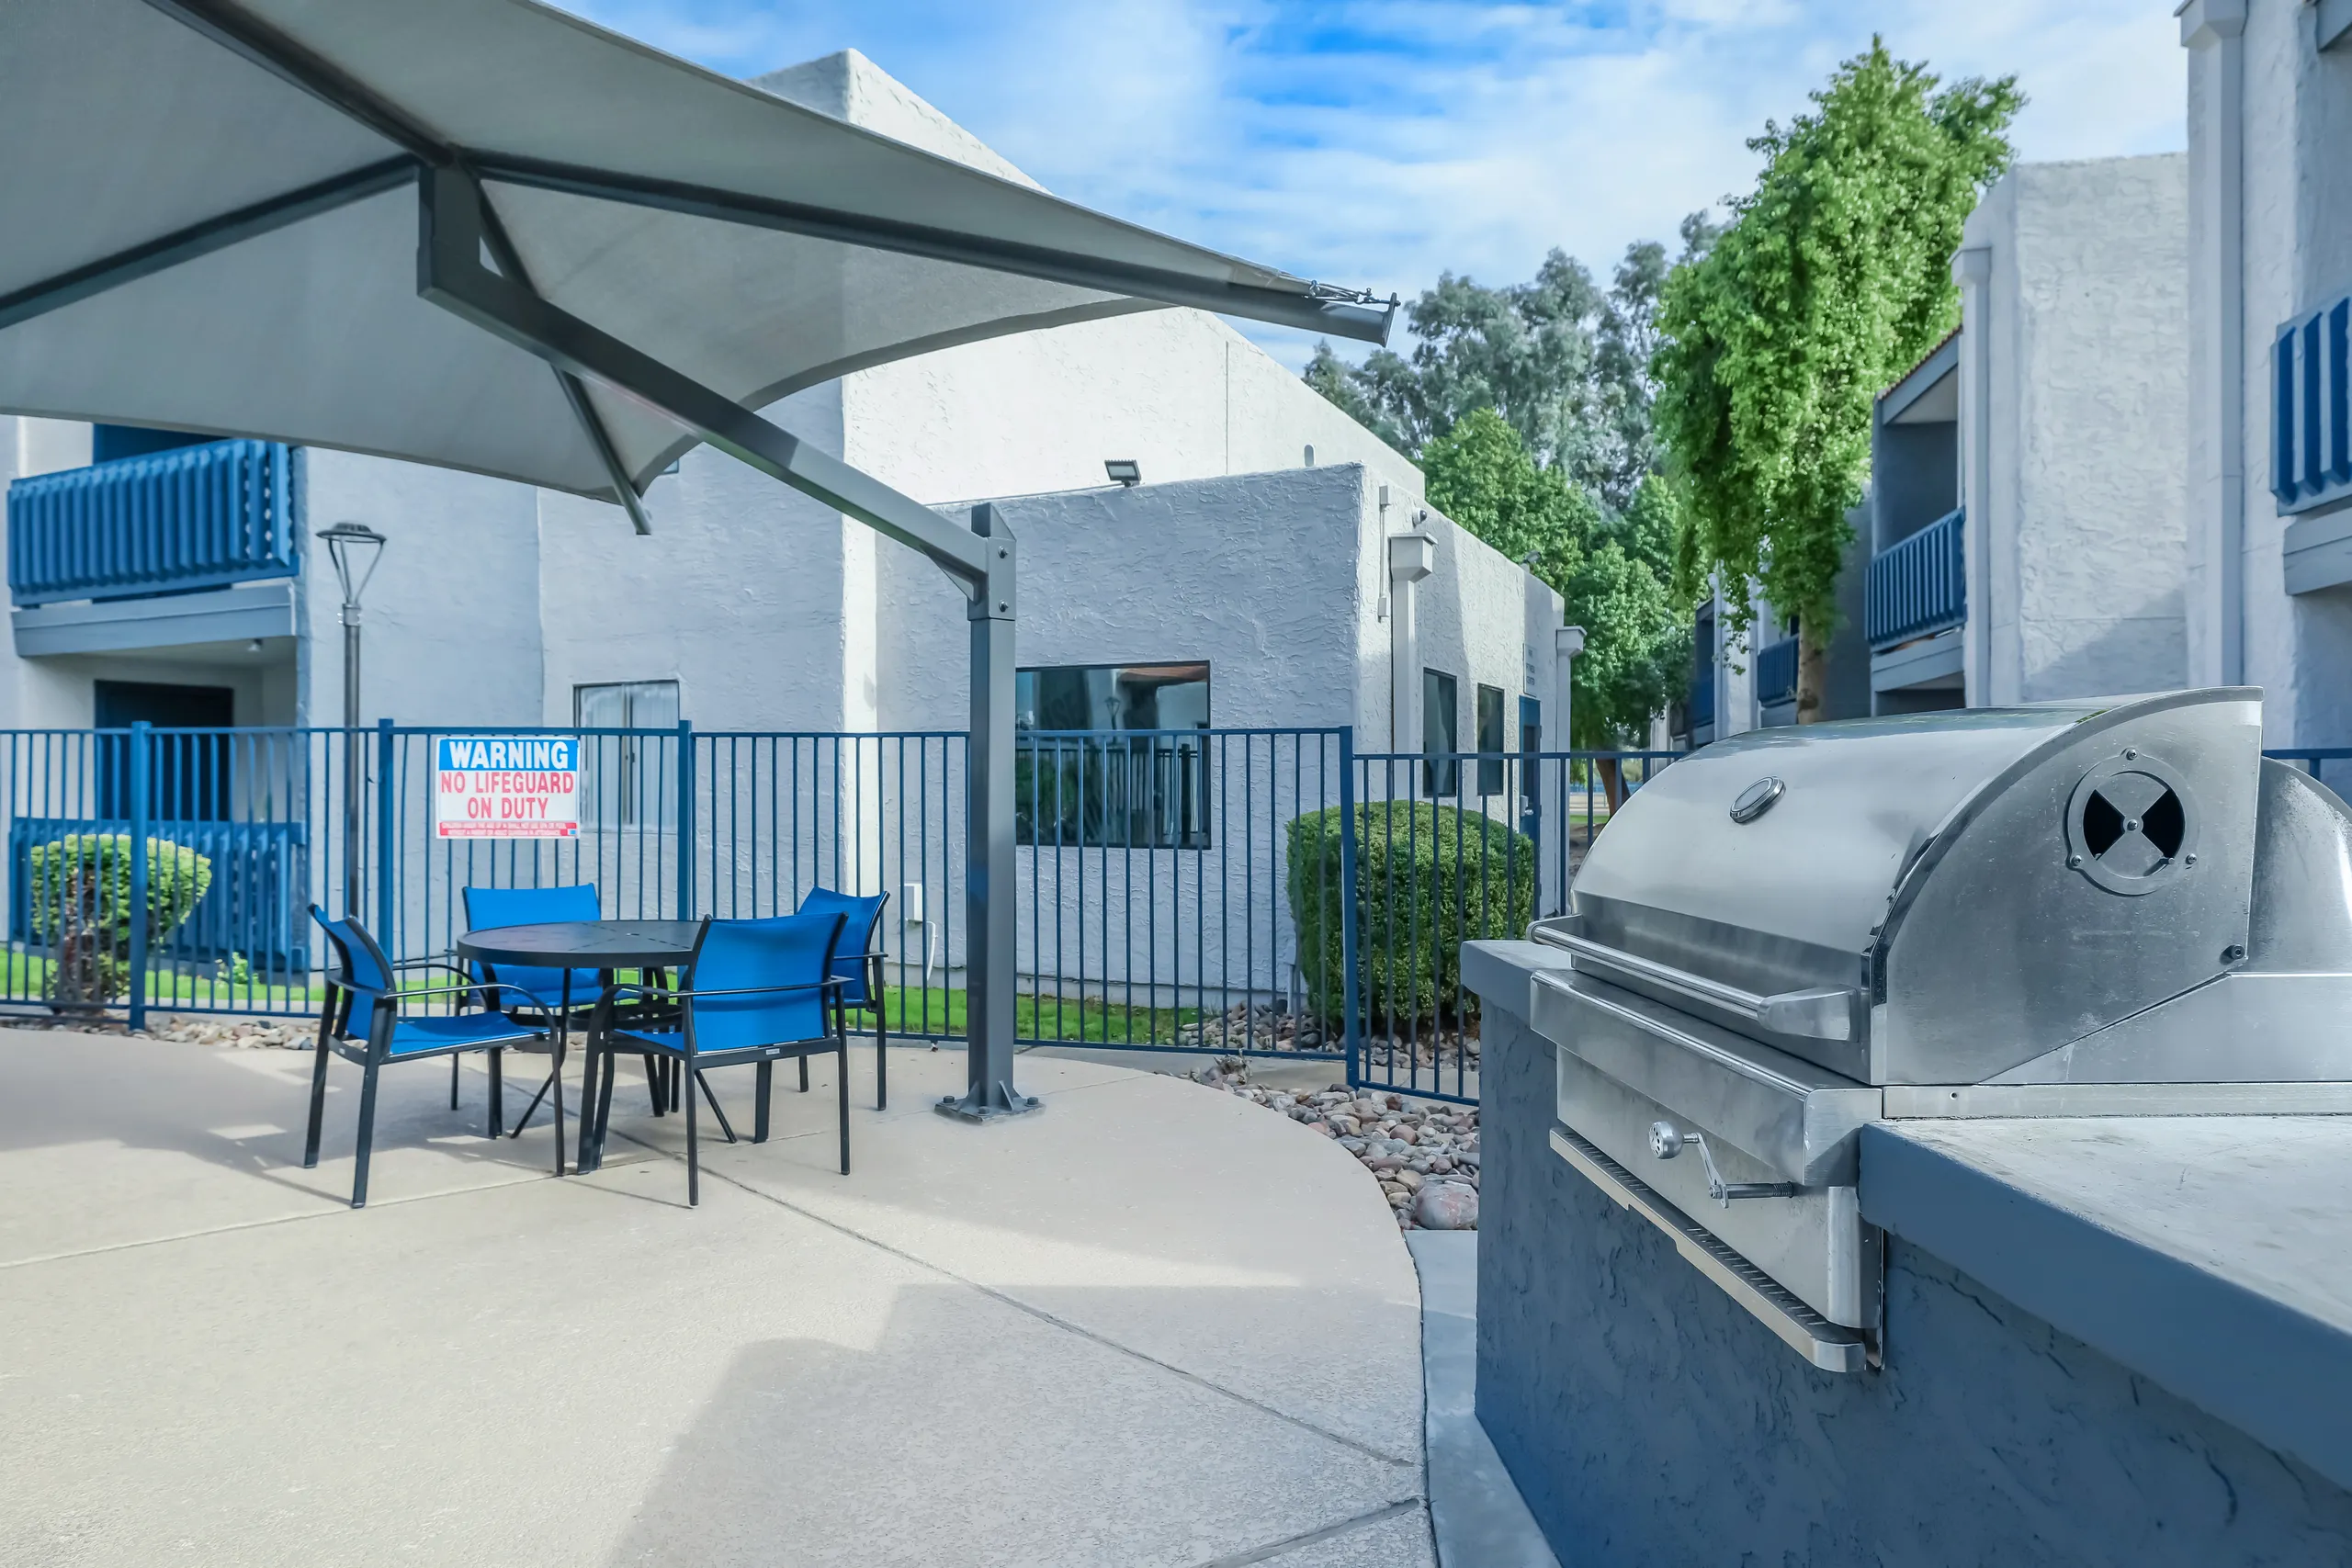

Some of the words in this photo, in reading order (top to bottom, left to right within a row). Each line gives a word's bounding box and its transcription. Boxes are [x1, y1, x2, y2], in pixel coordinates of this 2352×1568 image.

[448, 741, 569, 769] WARNING
[441, 772, 466, 794] NO
[475, 772, 574, 794] LIFEGUARD
[468, 797, 492, 818] ON
[502, 797, 548, 818] DUTY
